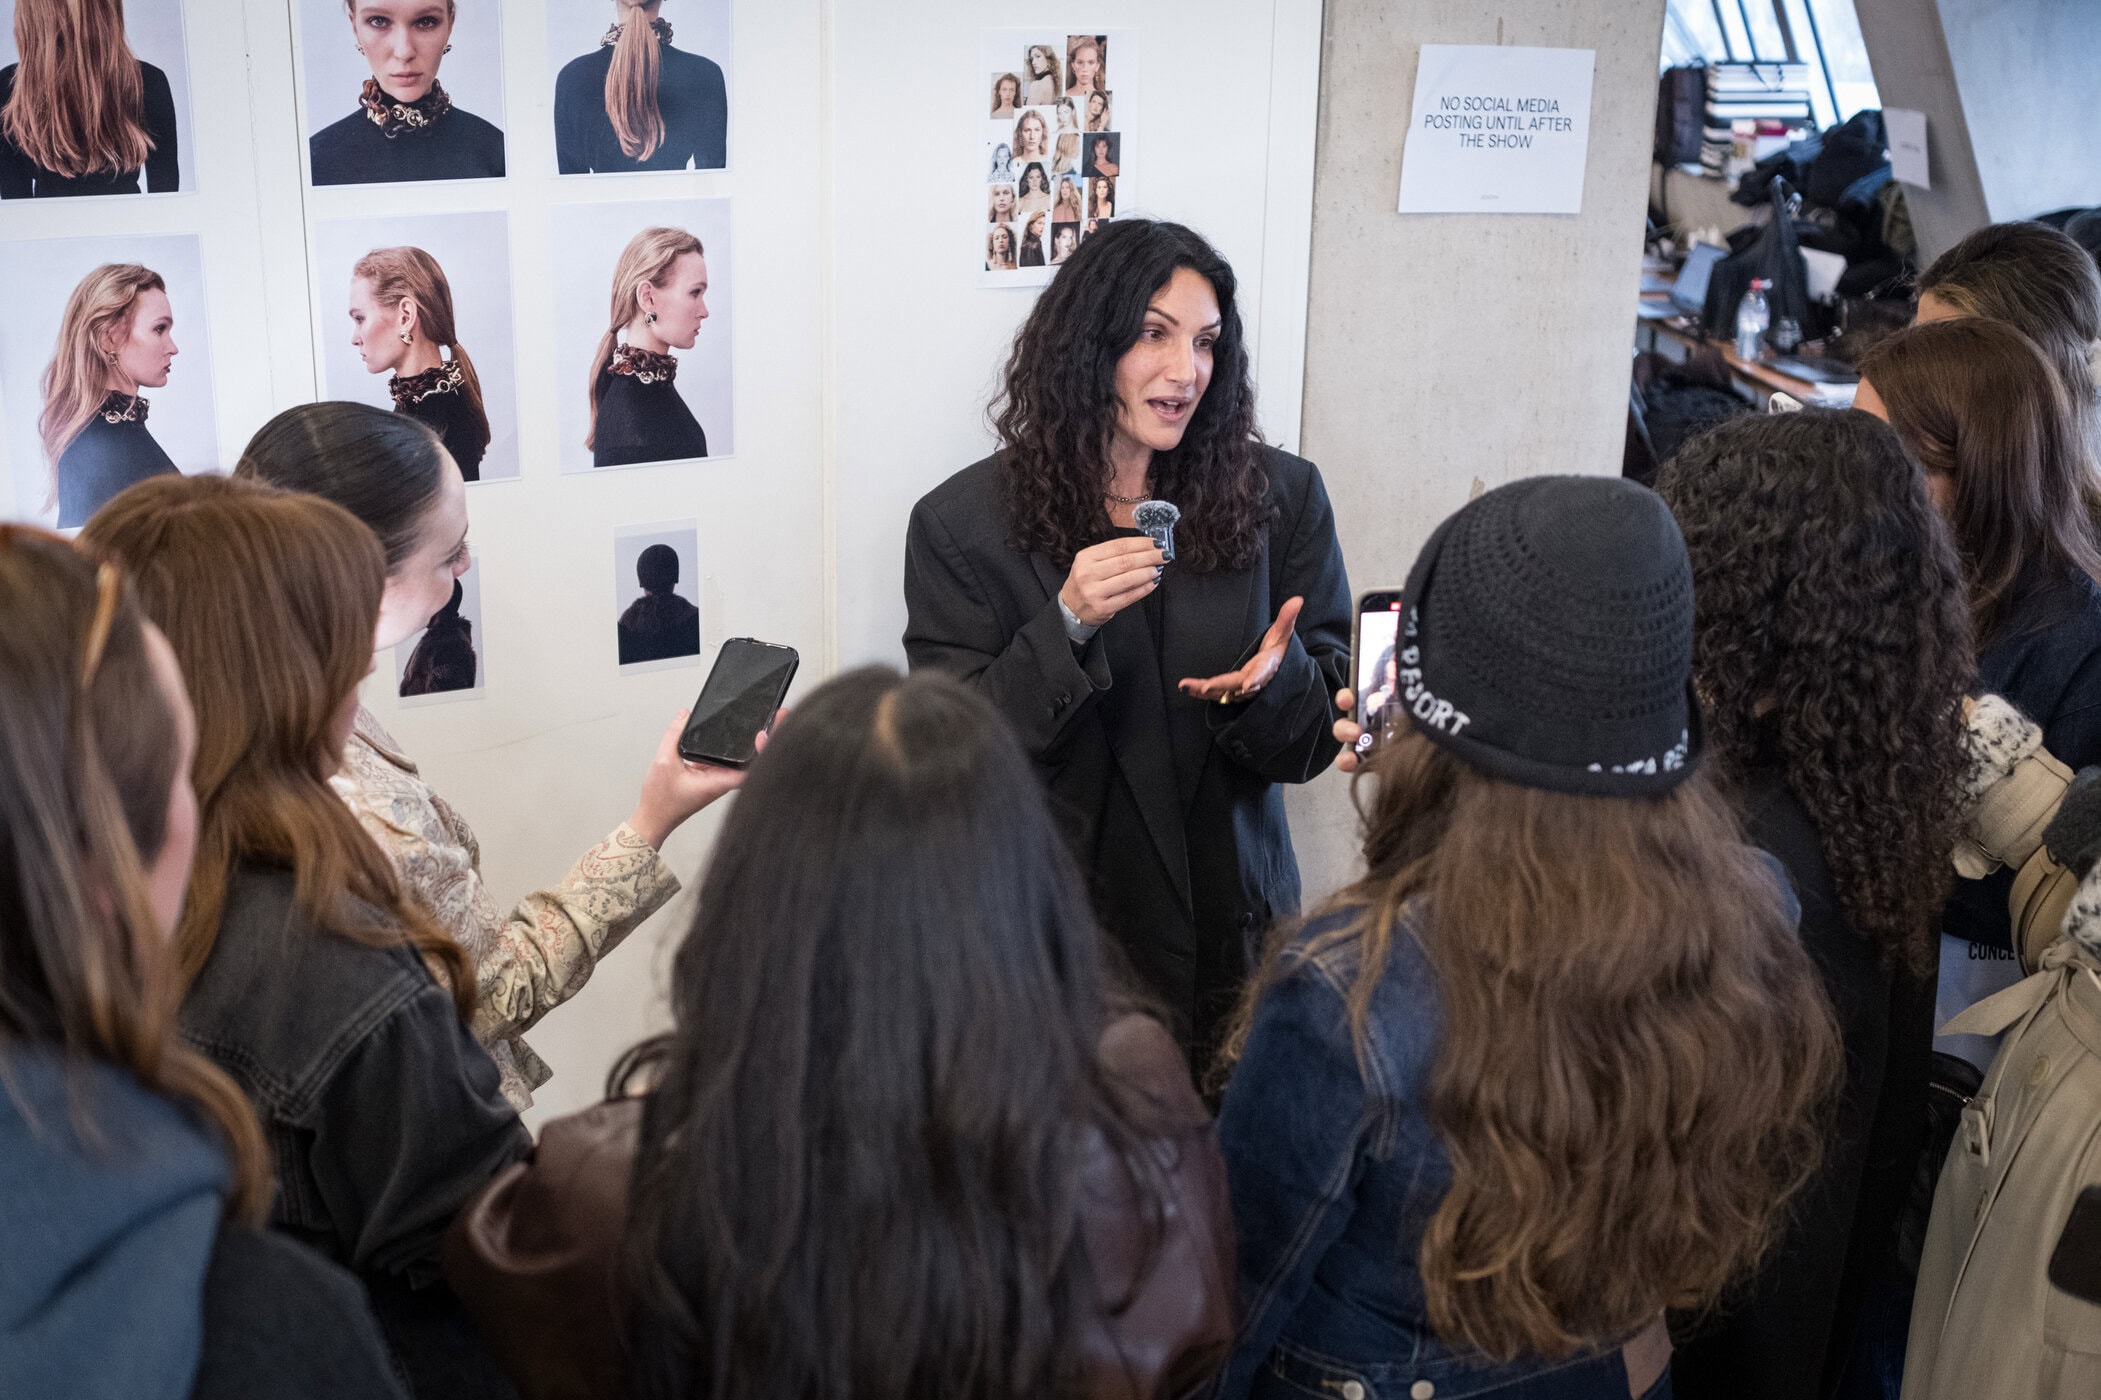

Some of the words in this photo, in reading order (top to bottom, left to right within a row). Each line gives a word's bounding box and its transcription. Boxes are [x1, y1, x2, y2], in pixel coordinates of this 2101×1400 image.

[1440, 96, 1460, 111] NO
[1463, 96, 1513, 112] SOCIAL
[1516, 98, 1560, 113] MEDIA
[1424, 114, 1482, 130] POSTING
[1486, 115, 1525, 131] UNTIL
[1528, 117, 1573, 132] AFTER
[1459, 133, 1485, 148] THE
[1488, 134, 1533, 149] SHOW
